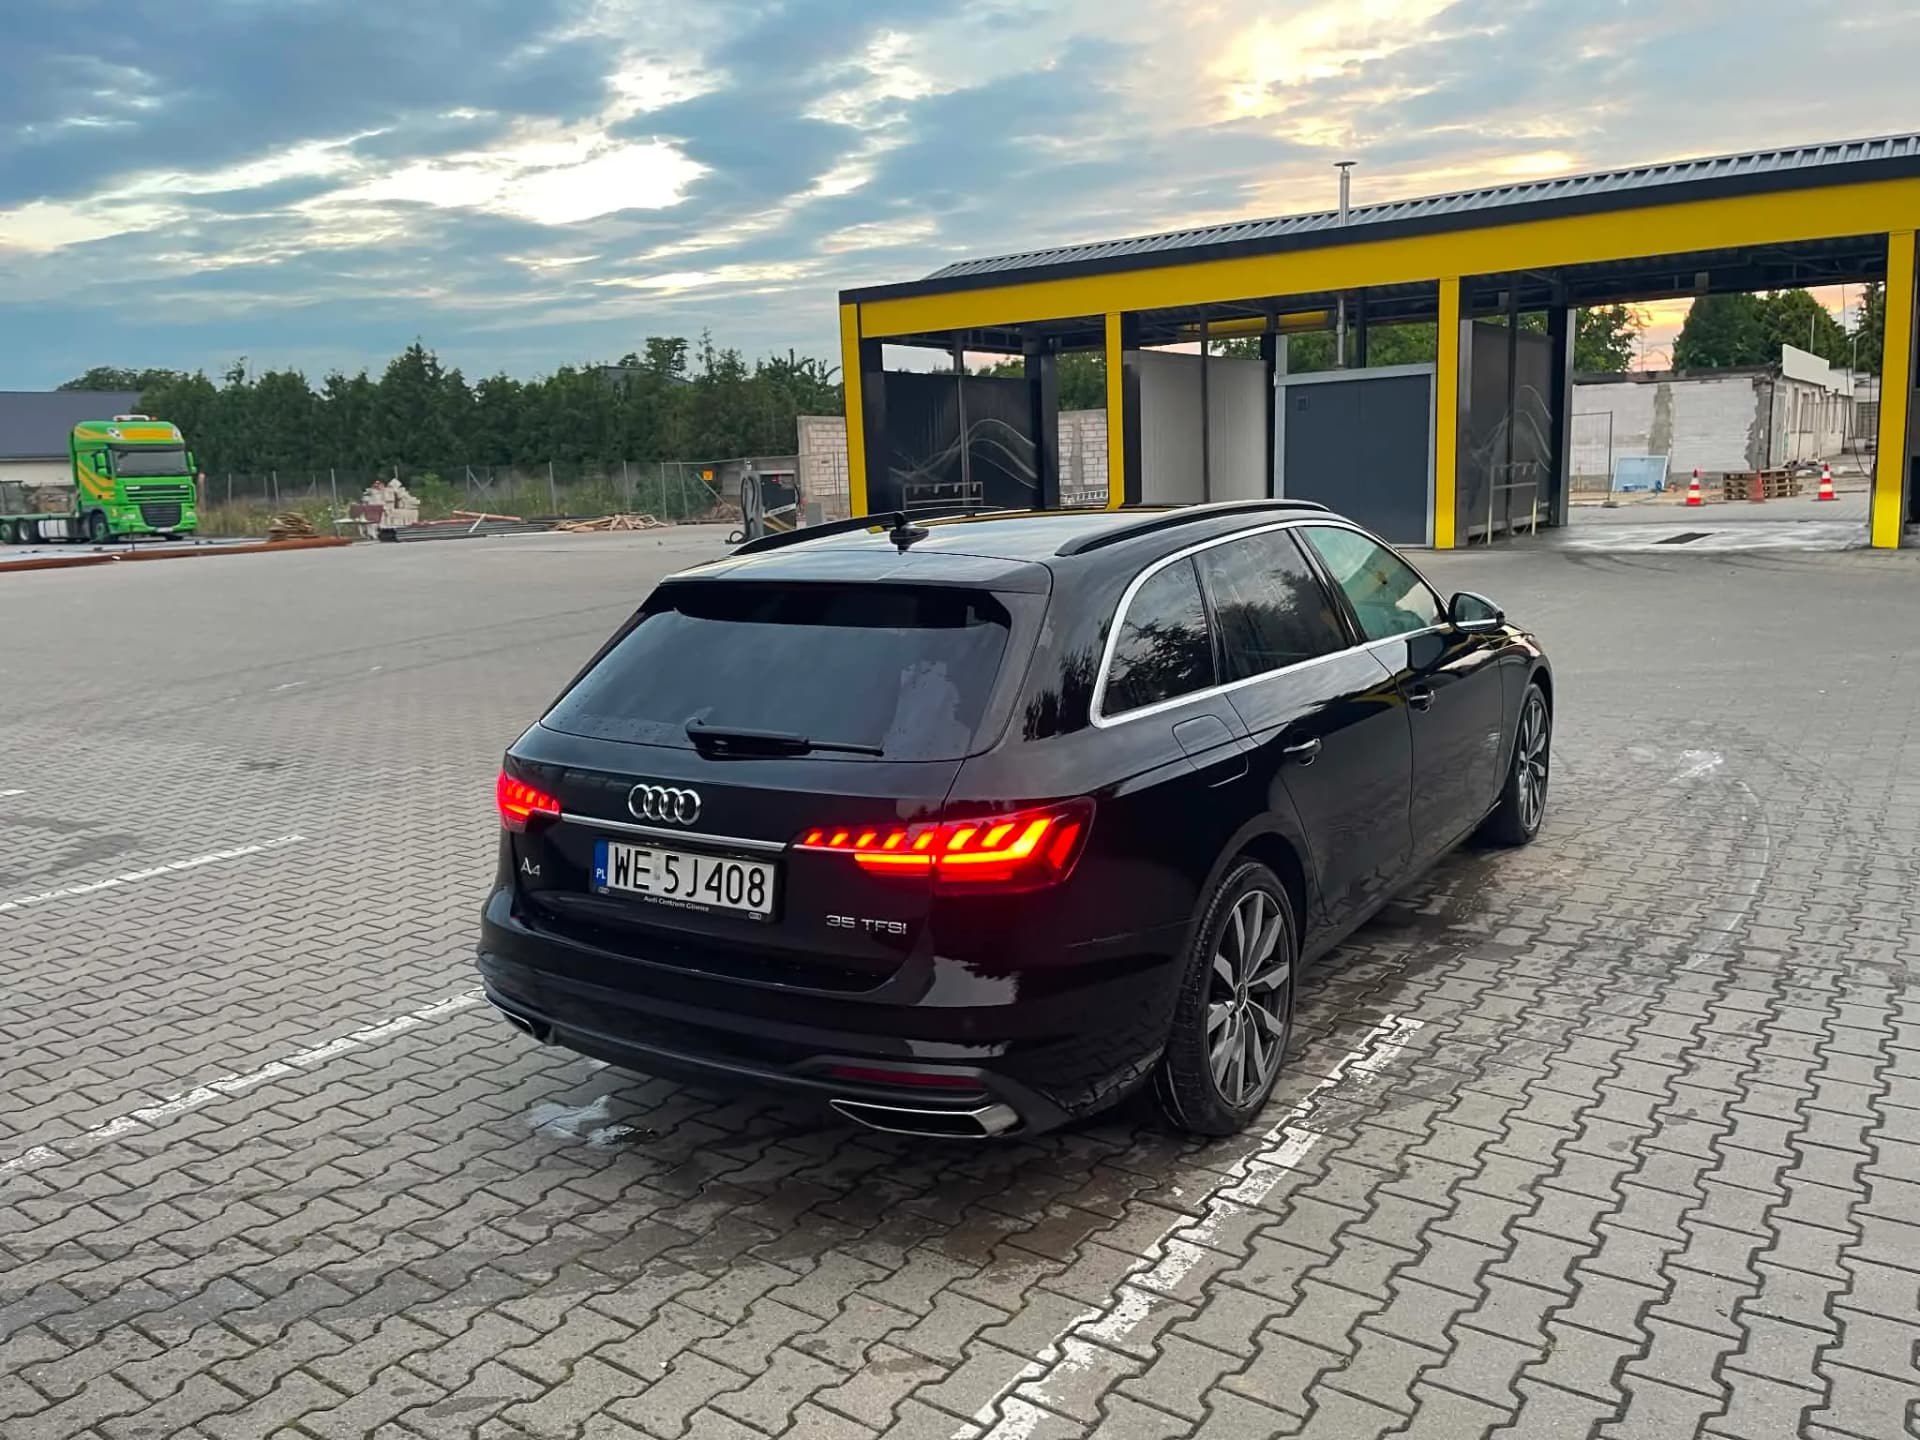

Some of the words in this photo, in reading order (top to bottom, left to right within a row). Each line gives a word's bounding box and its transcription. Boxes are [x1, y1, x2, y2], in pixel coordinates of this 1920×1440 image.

[520, 856, 541, 877] A4
[596, 867, 606, 880] PL
[614, 846, 651, 890] WE
[663, 854, 765, 908] 5J408
[826, 914, 856, 929] 35
[860, 918, 907, 934] TFSI
